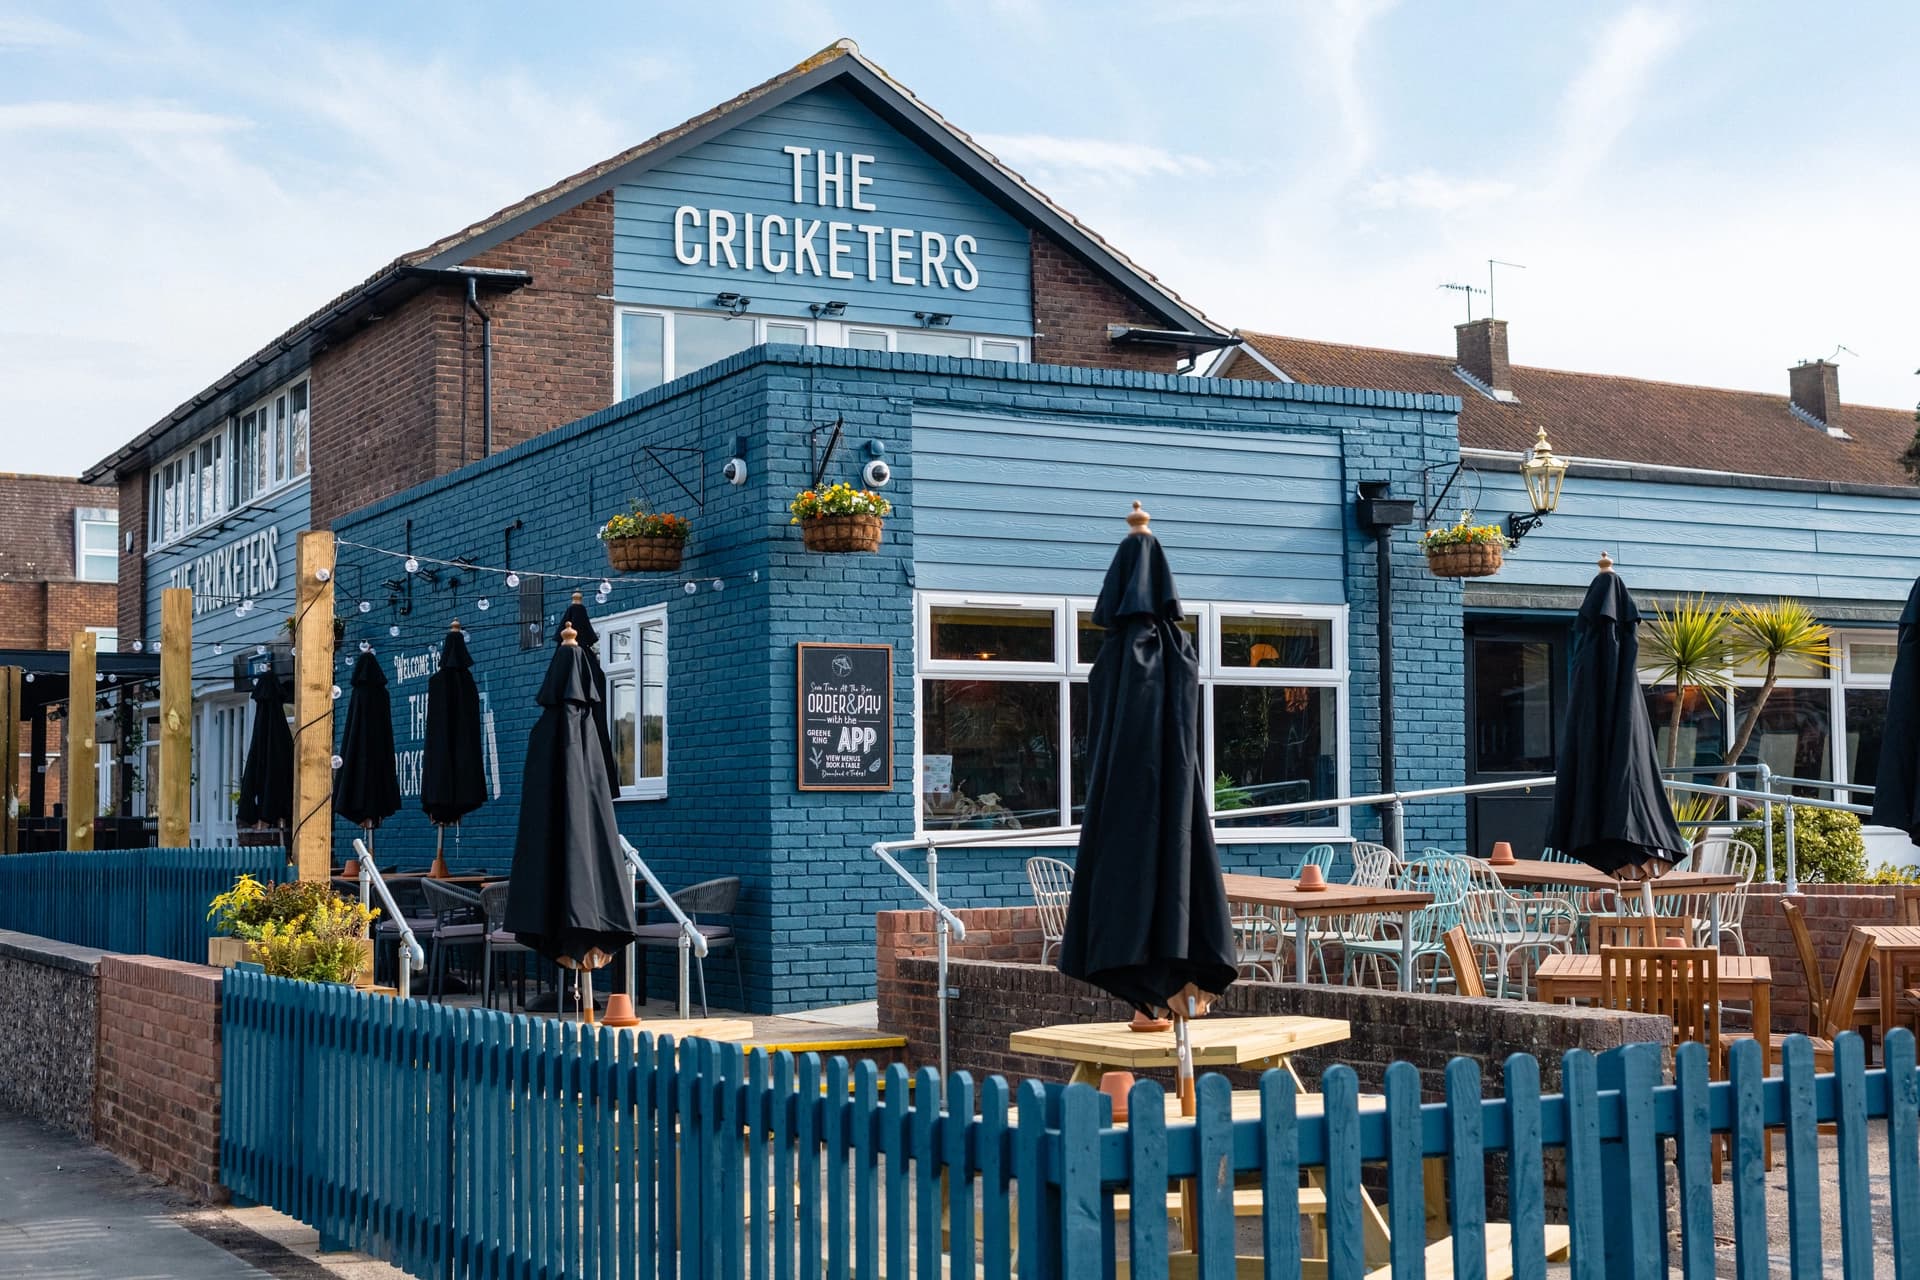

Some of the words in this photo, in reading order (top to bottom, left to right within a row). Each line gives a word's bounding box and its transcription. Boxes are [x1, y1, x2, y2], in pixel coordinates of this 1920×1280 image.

[784, 145, 877, 212] THE
[674, 205, 979, 292] CRICKETERS
[195, 525, 279, 615] CRICKETERS
[806, 729, 831, 737] GREENE
[827, 715, 843, 724] with
[844, 715, 857, 725] the
[837, 726, 877, 754] APP
